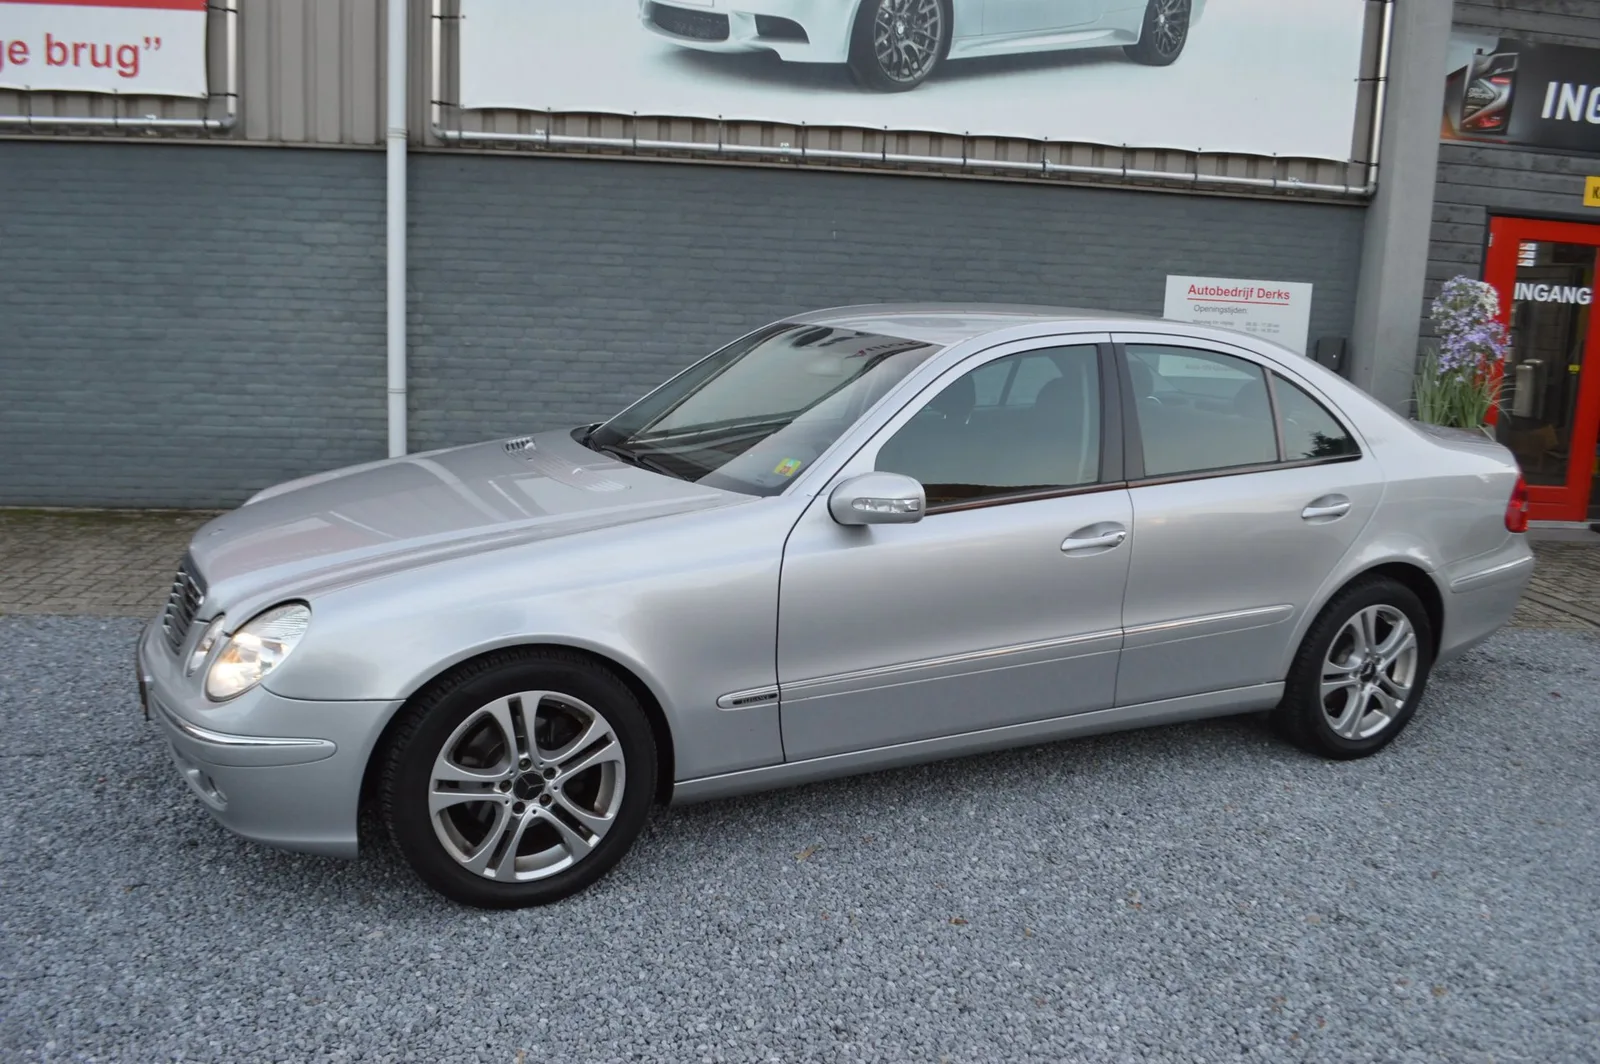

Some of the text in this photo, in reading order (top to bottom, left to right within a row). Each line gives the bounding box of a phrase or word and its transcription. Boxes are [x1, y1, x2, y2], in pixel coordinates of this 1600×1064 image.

[0, 39, 29, 73] e
[1188, 284, 1290, 300] Autobedrijf Derks
[1513, 282, 1592, 305] INGANG
